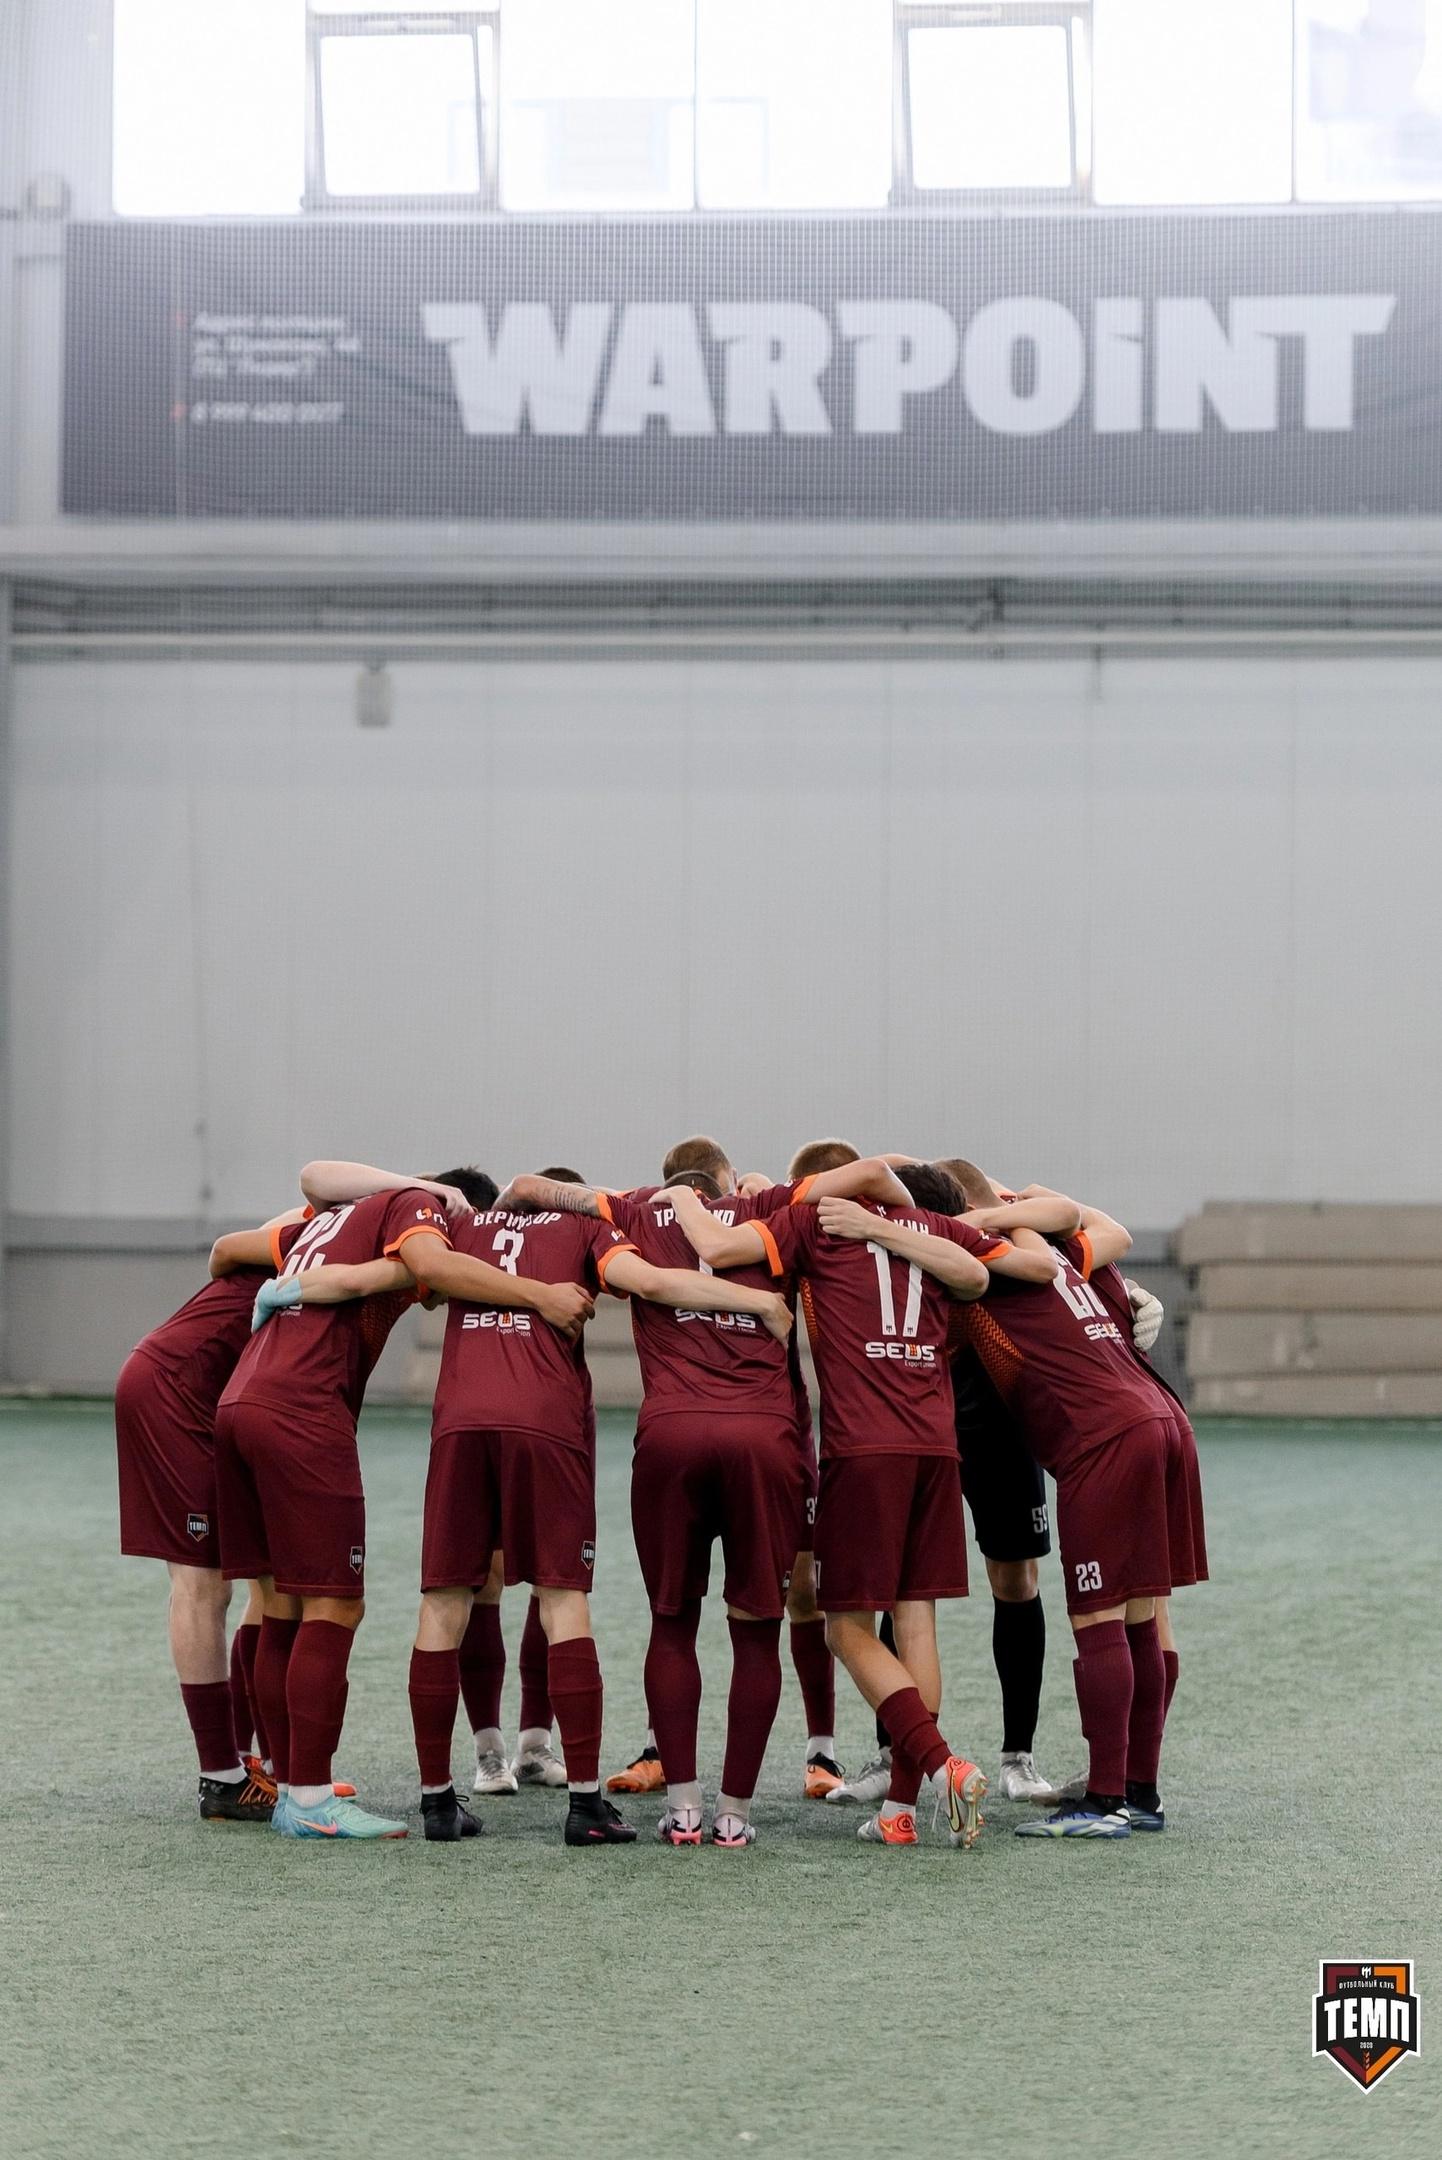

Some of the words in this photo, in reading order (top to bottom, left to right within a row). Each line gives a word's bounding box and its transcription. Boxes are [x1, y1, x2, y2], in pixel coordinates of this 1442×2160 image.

[462, 1311, 531, 1330] SEUS
[865, 1341, 936, 1361] SEUS
[1075, 1561, 1103, 1593] 23
